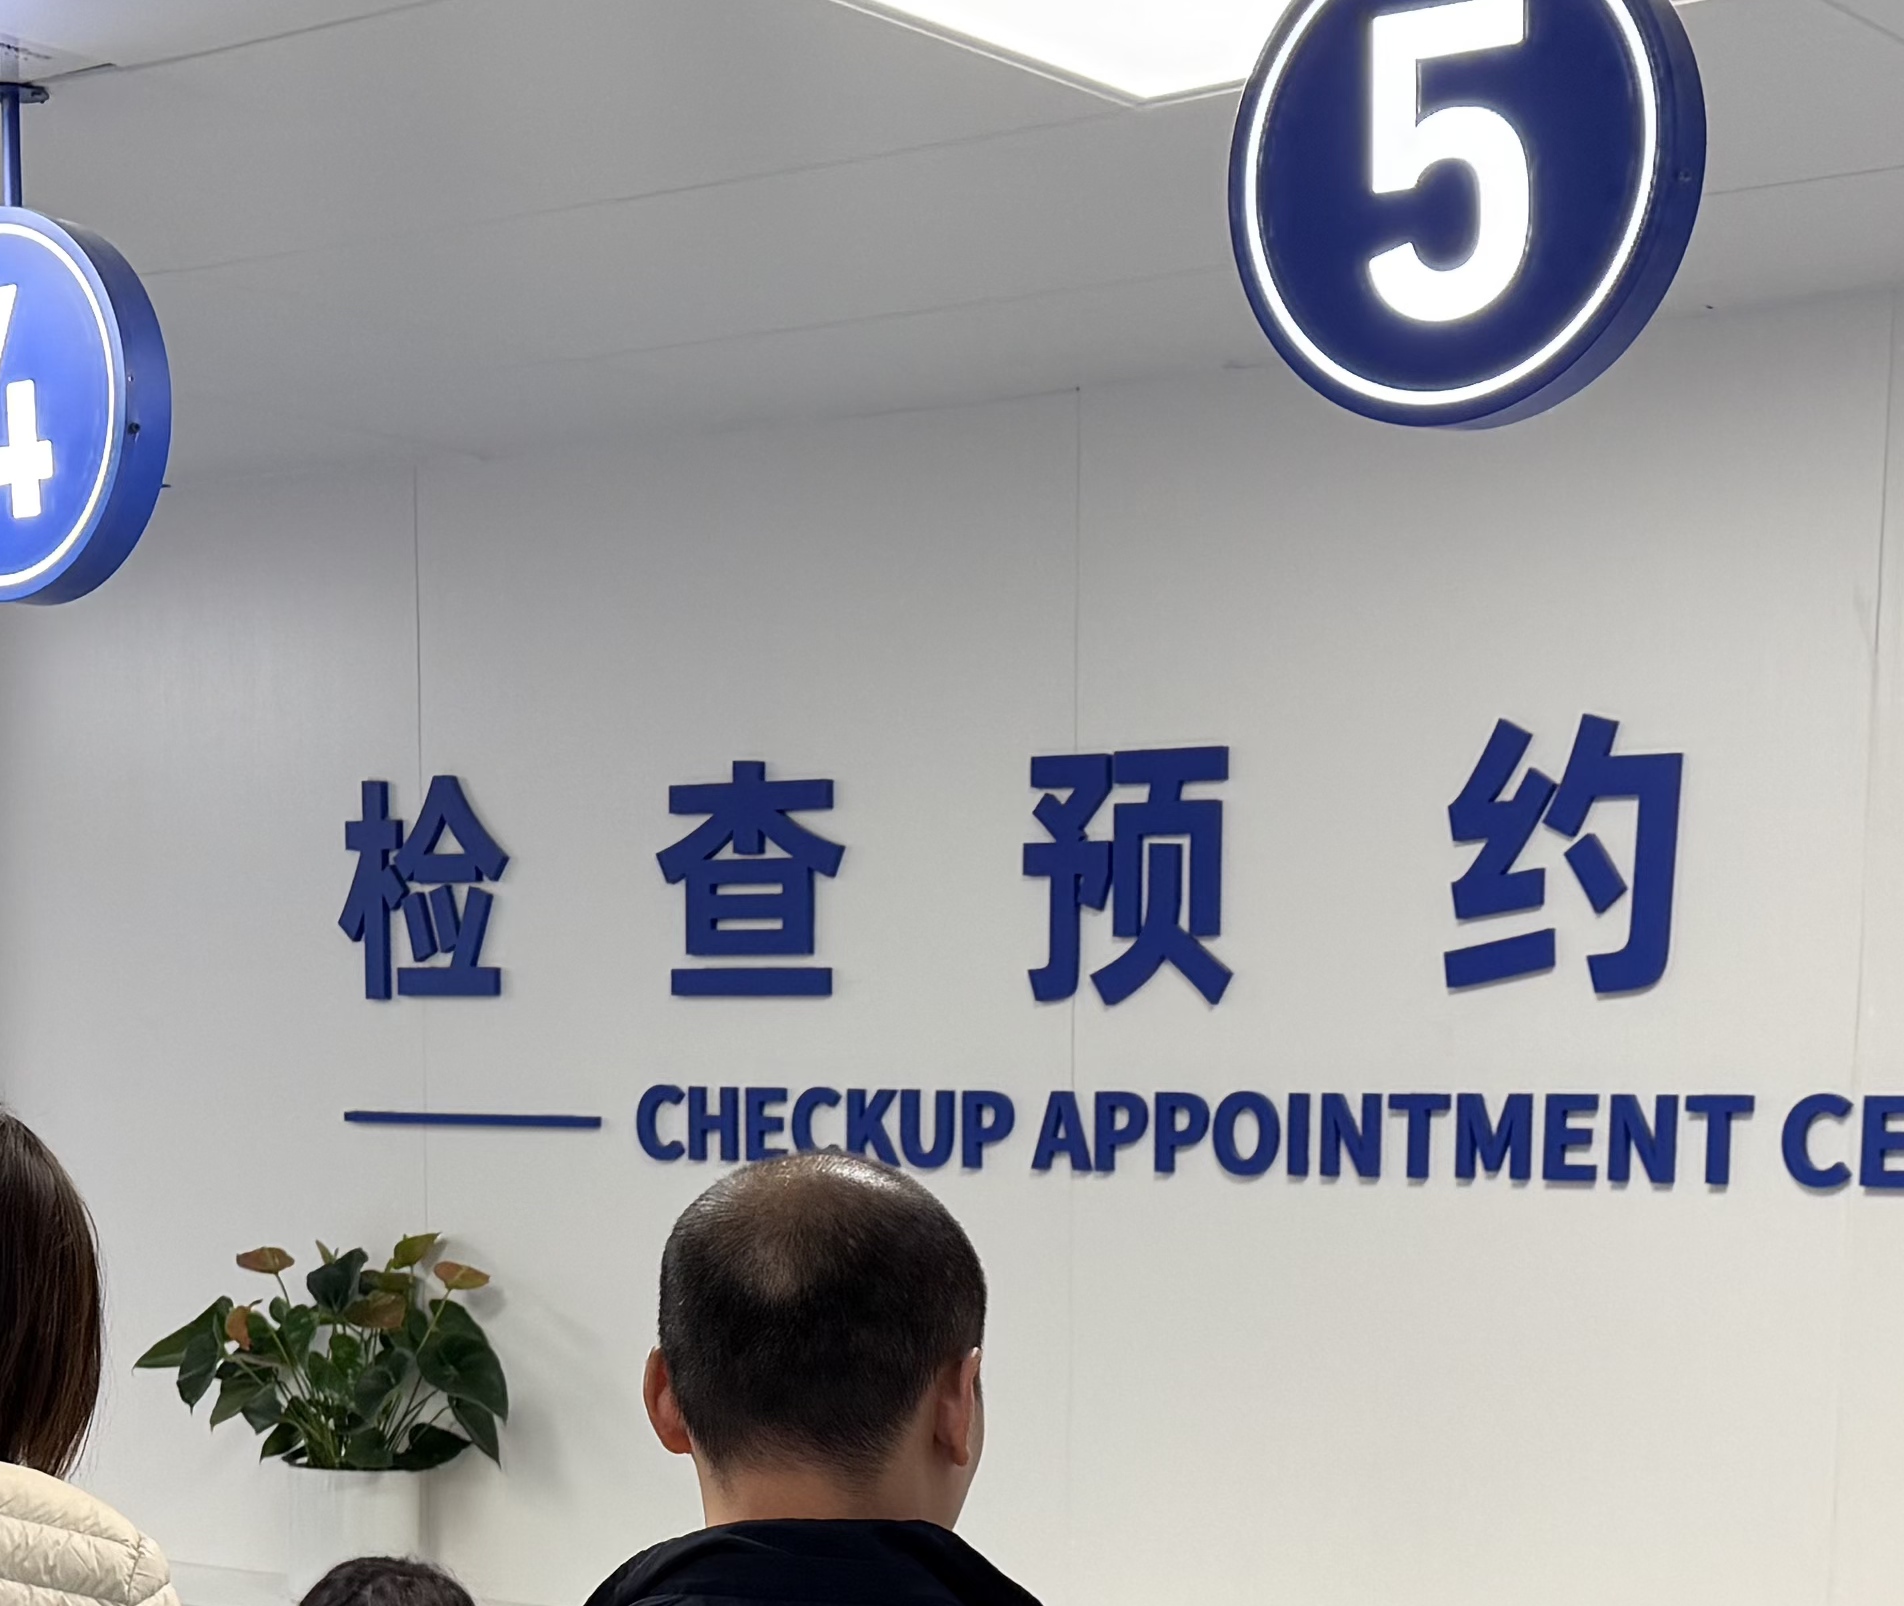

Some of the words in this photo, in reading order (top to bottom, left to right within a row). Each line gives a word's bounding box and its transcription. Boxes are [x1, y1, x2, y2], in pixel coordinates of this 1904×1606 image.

[1368, 0, 1530, 322] 5
[636, 1084, 1016, 1169] CHECKUP
[1031, 1089, 1756, 1186] APPOINTMENT
